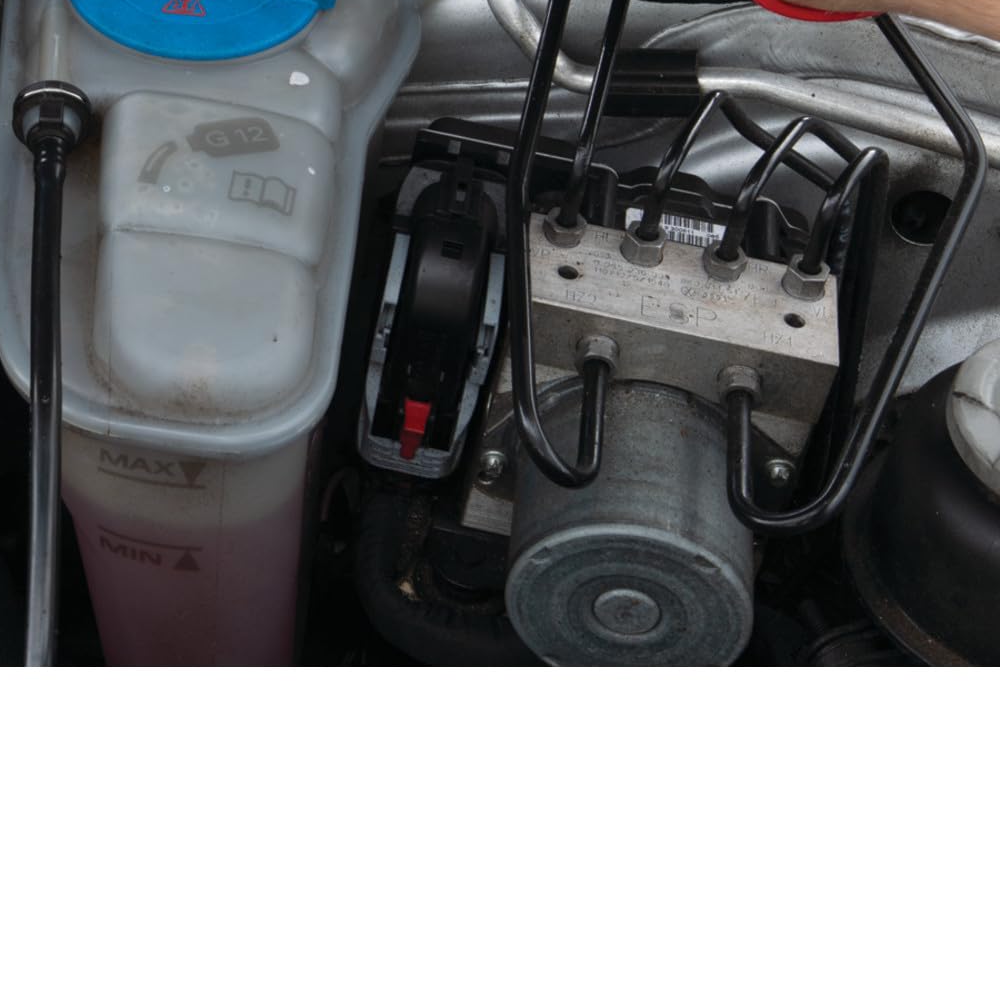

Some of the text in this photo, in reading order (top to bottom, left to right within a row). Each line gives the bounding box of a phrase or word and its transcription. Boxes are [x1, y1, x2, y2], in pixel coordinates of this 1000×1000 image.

[206, 126, 270, 148] G 12
[100, 448, 176, 478] MAX
[99, 536, 162, 566] MIN
